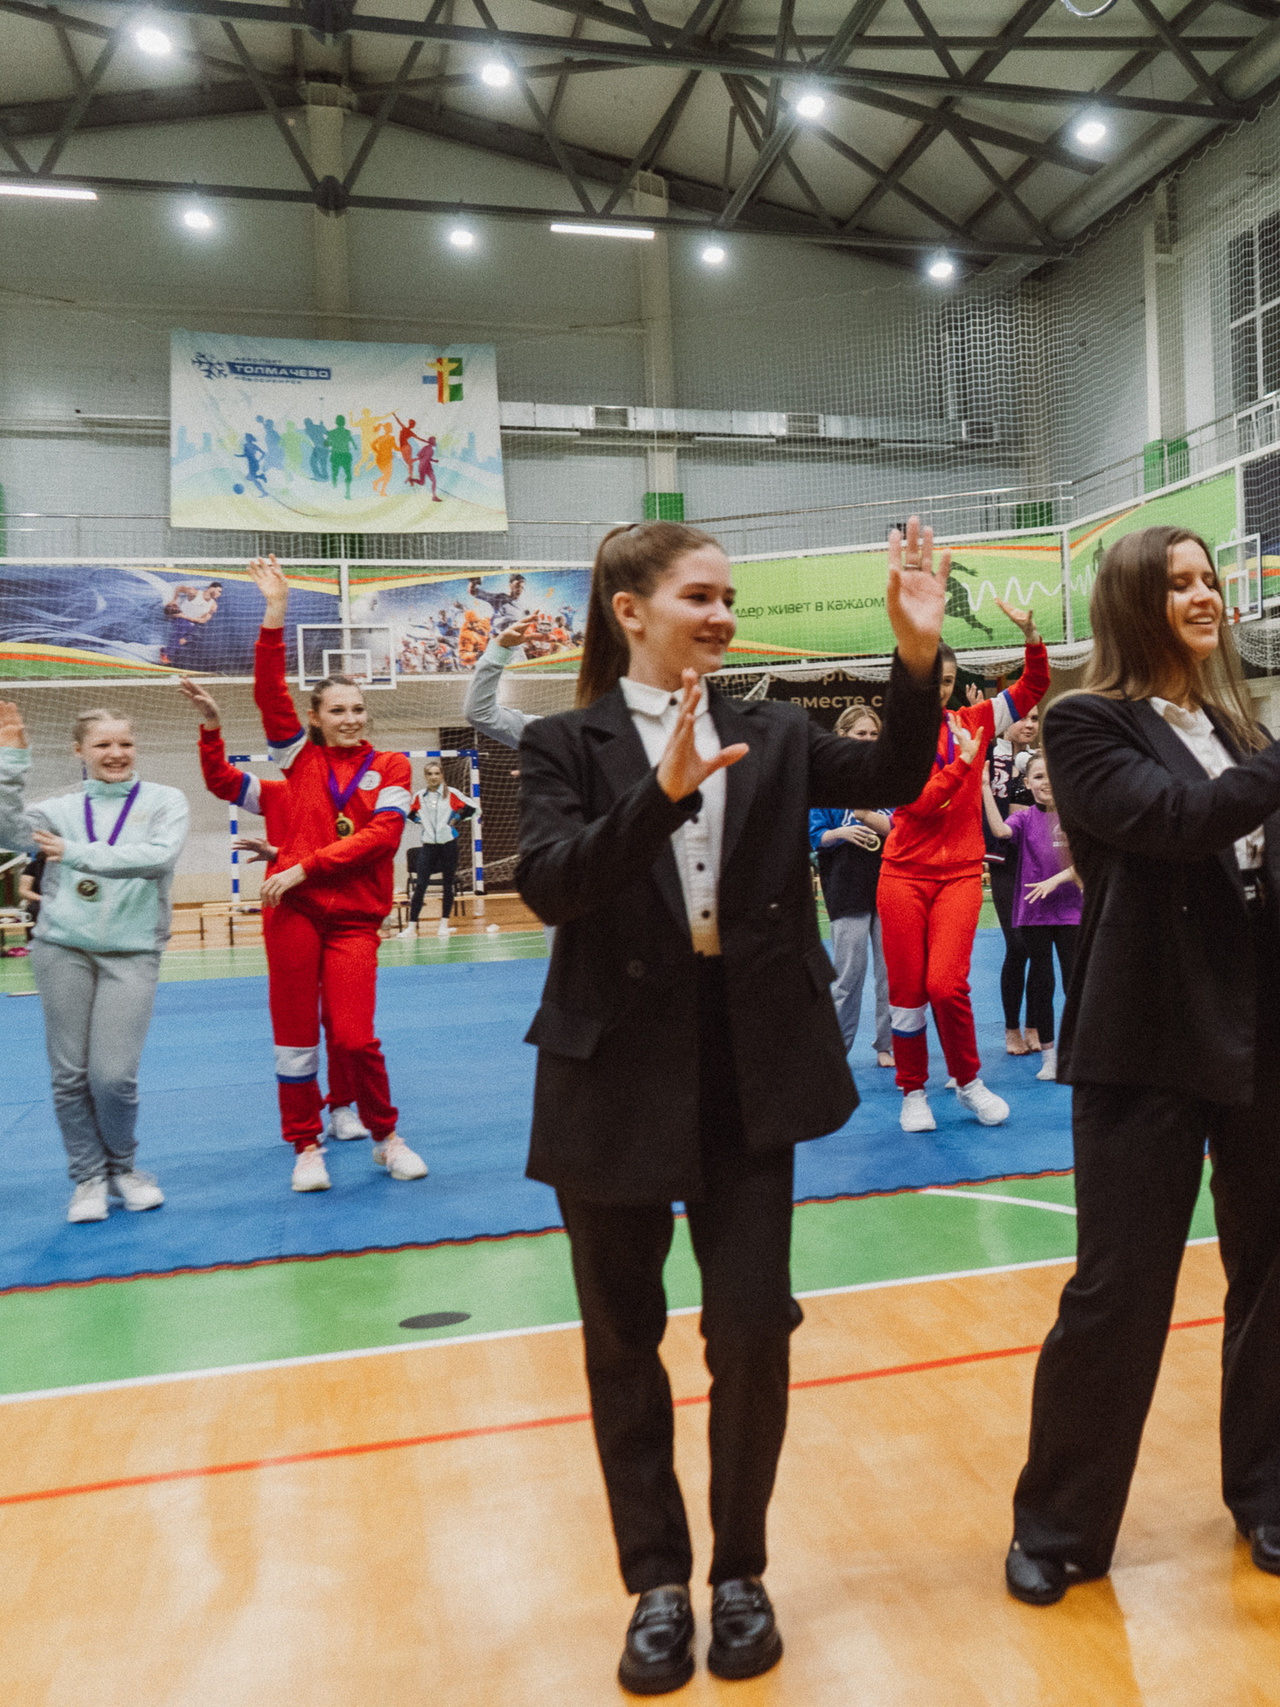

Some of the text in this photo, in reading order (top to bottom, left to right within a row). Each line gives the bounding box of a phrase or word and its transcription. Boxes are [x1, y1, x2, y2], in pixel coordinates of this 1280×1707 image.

[234, 365, 329, 378] ТОЛМАЧЕВО
[733, 605, 764, 619] идер
[768, 602, 811, 616] живет
[815, 601, 824, 612] в
[791, 695, 866, 709] вместе
[872, 695, 883, 707] с
